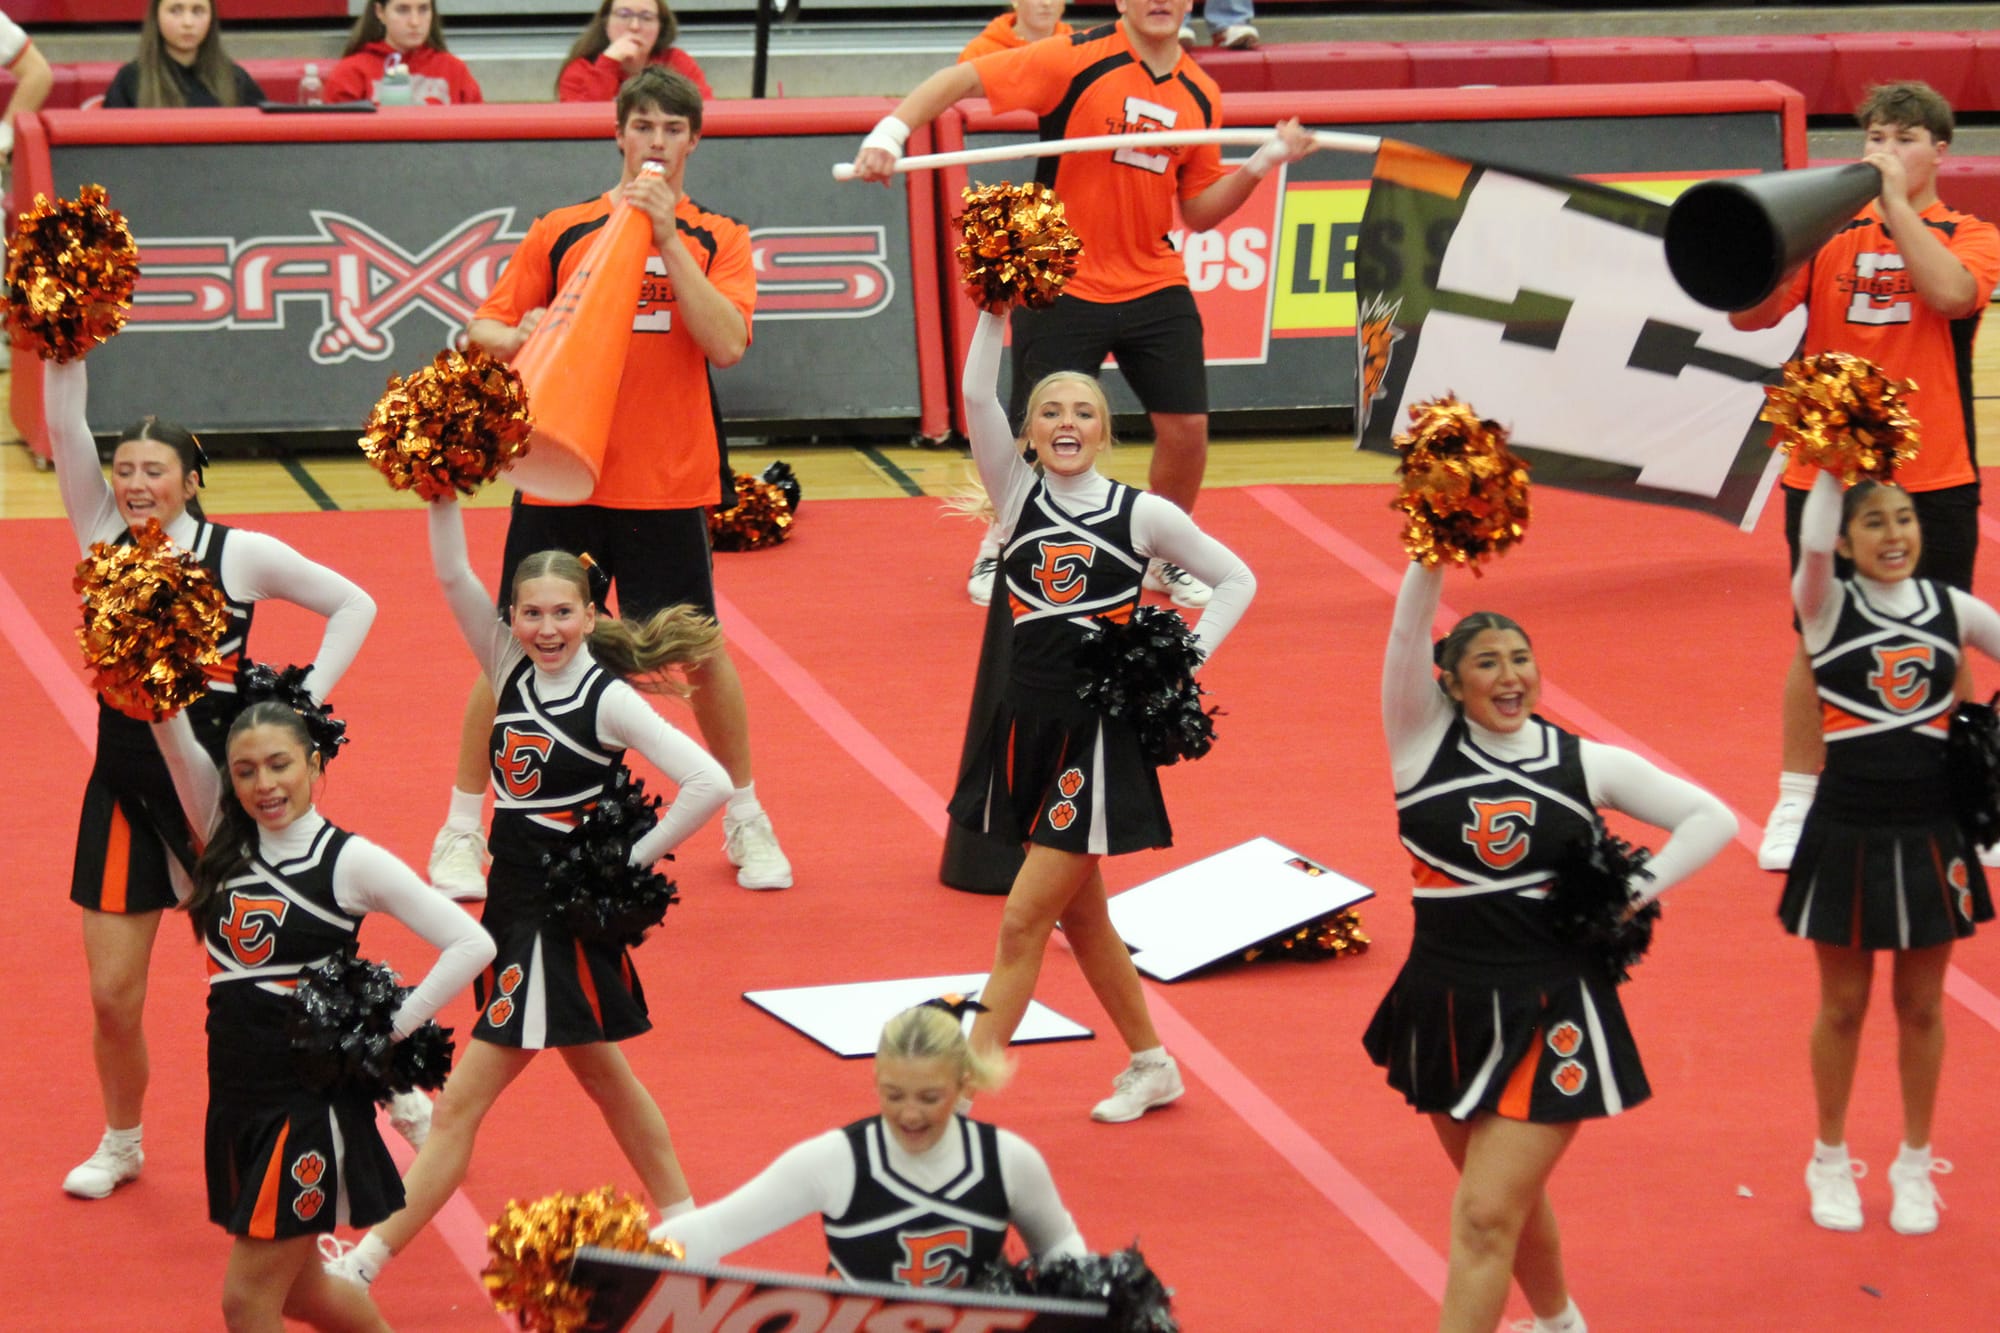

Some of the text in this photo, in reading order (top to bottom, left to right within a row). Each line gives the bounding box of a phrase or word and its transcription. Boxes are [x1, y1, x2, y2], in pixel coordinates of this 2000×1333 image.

[1112, 96, 1178, 176] E
[127, 206, 895, 365] SAXS
[1836, 273, 1917, 294] TIGER
[1845, 252, 1912, 327] E
[1031, 540, 1096, 608] E
[1867, 642, 1936, 714] E
[495, 726, 555, 799] E
[1461, 796, 1537, 871] E
[219, 890, 290, 969] E
[892, 1224, 972, 1290] E
[617, 1270, 1040, 1333] NOIS
